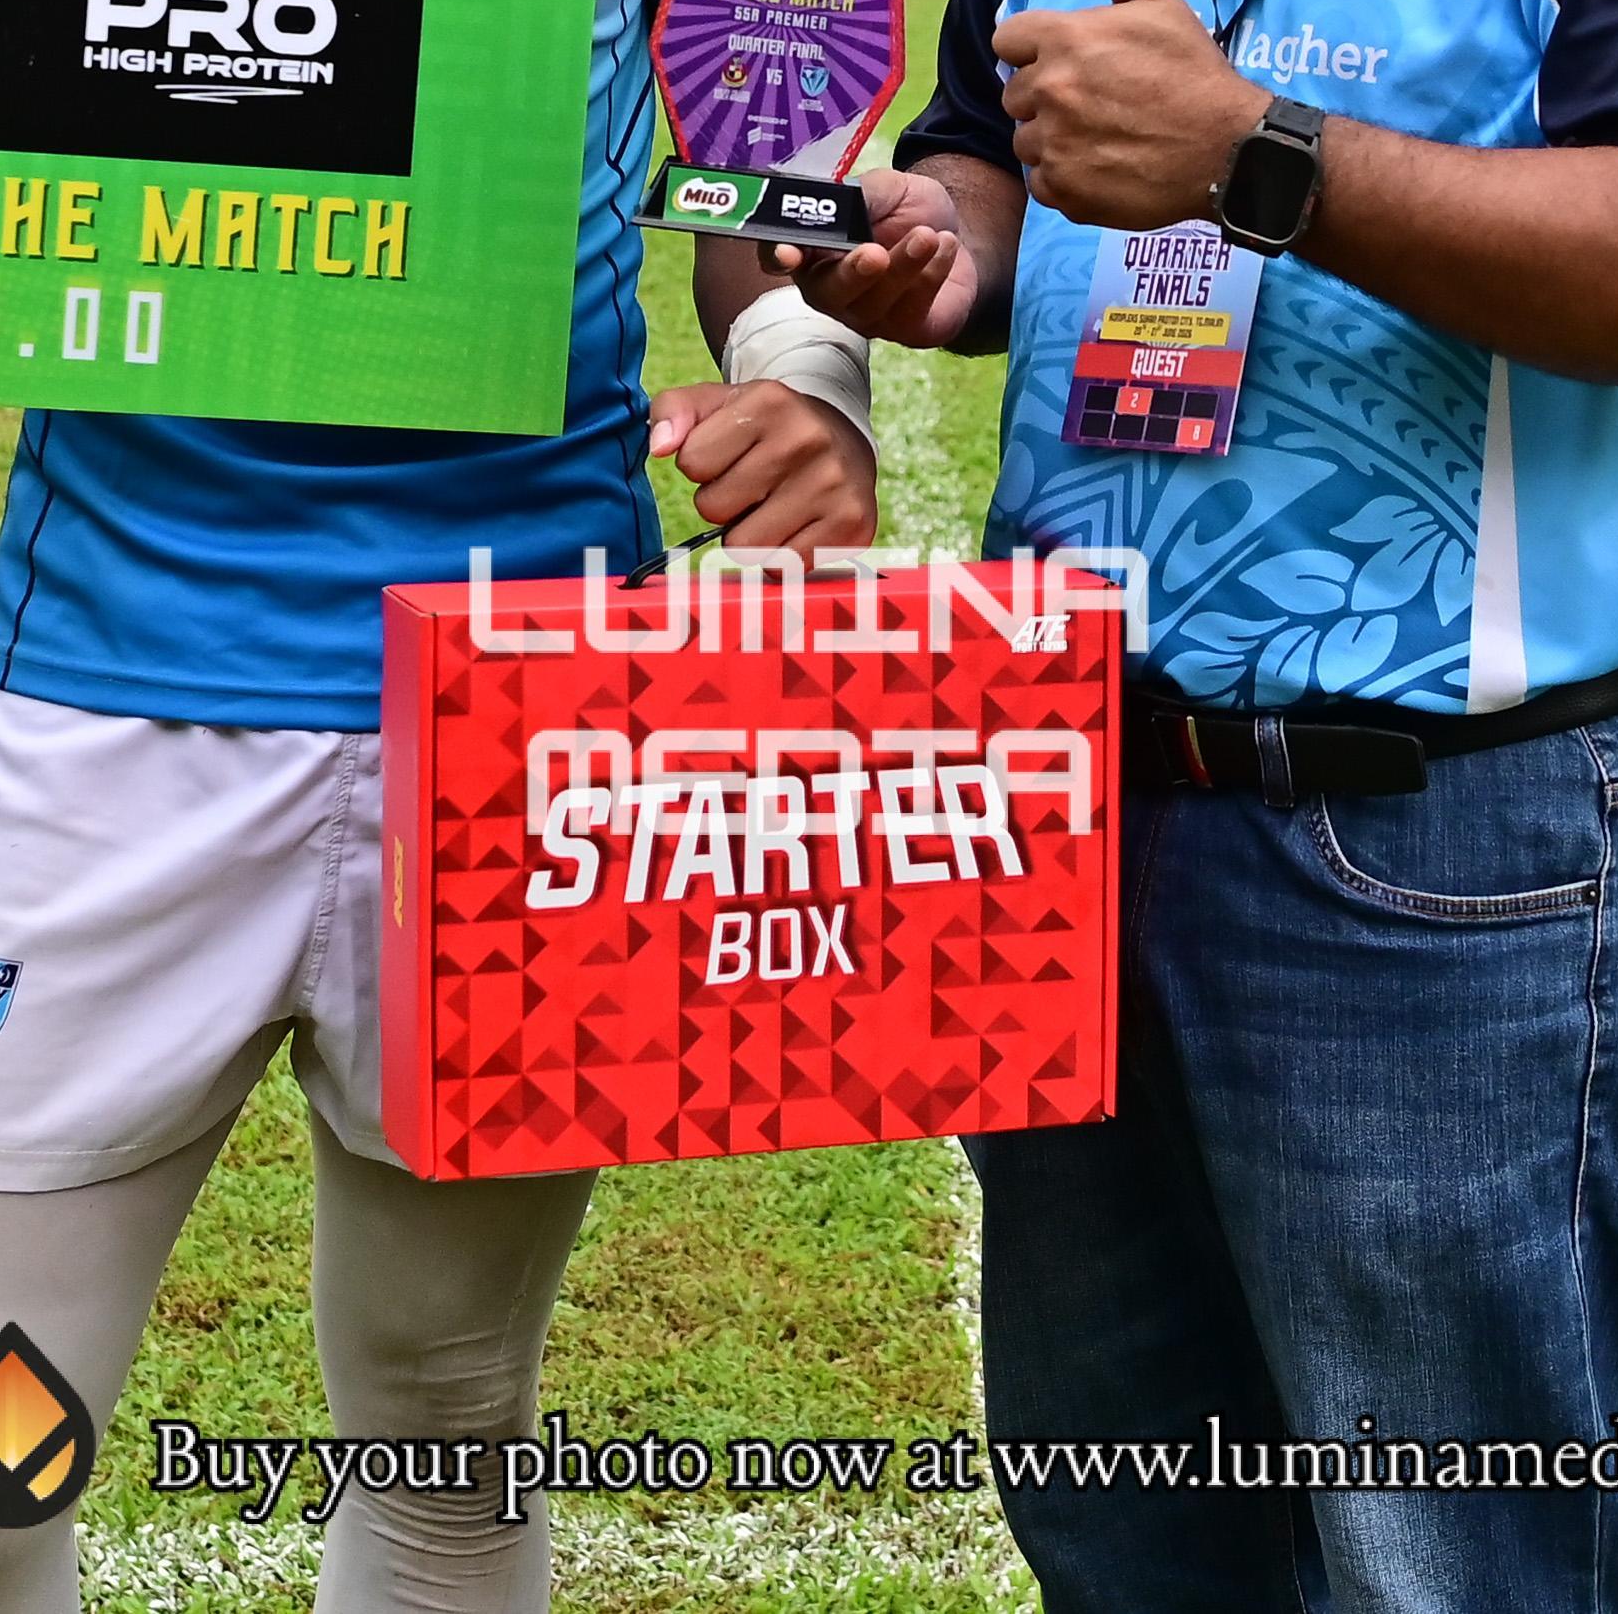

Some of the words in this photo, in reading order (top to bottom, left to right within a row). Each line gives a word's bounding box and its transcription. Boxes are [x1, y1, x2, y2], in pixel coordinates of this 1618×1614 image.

[734, 6, 760, 22] SSR
[766, 10, 828, 31] PREMIER
[728, 34, 785, 56] QUARTER
[789, 41, 826, 61] FINAL
[1228, 18, 1388, 84] lagher
[83, 46, 173, 73] HIGH
[183, 53, 334, 84] PROTEIN
[766, 68, 783, 85] VS
[683, 187, 730, 206] MILO
[781, 194, 837, 216] PRO
[139, 185, 412, 281] MATCH
[1124, 236, 1232, 272] QUARTER
[1133, 273, 1212, 307] FINALS
[1131, 348, 1189, 378] GUEST
[1130, 392, 1139, 408] 2
[1192, 424, 1202, 440] 8
[524, 764, 1025, 910] STARTER
[705, 903, 856, 986] BOX
